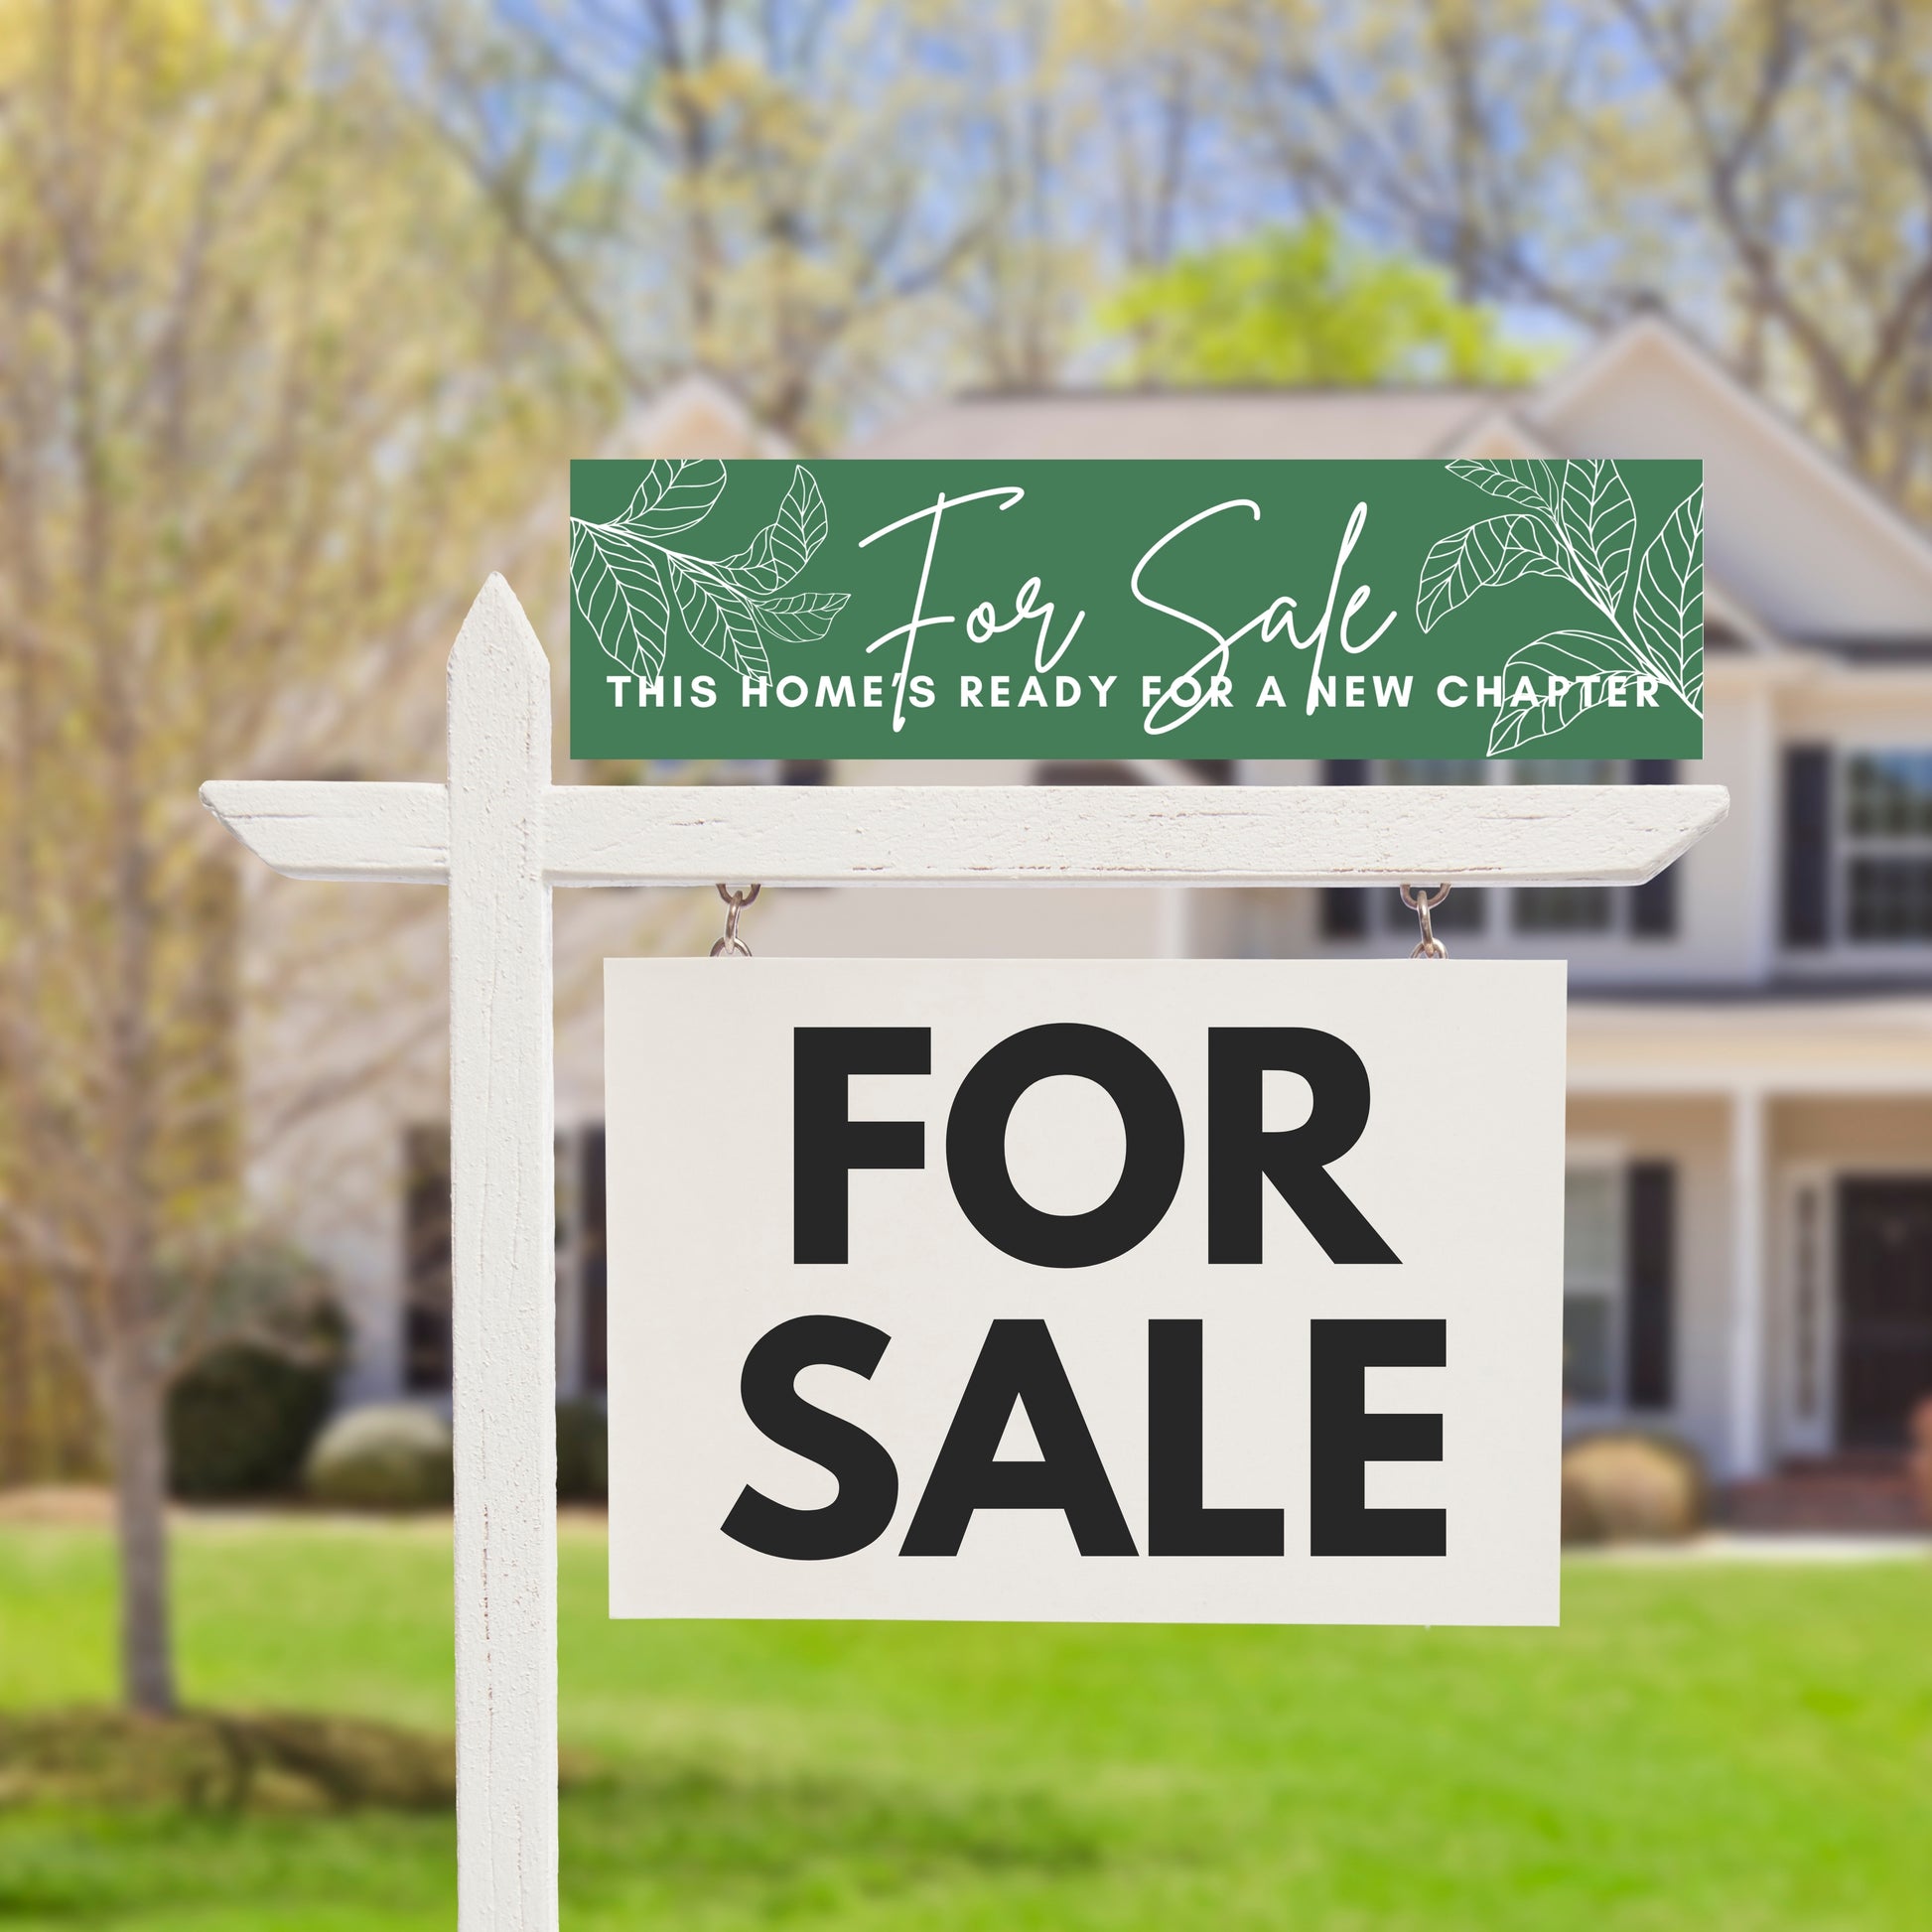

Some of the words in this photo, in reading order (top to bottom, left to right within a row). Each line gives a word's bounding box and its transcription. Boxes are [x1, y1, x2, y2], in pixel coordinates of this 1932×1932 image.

[606, 675, 718, 708] THIS
[960, 675, 1118, 708] READY
[1142, 675, 1234, 708] FOR
[1255, 675, 1287, 708] A
[1313, 675, 1415, 708] NEW
[1436, 675, 1660, 708] CHAPTER
[858, 486, 1086, 733] For
[1131, 498, 1398, 736] Sale
[794, 1023, 1403, 1269] FOR
[720, 1314, 1447, 1562] SALE
